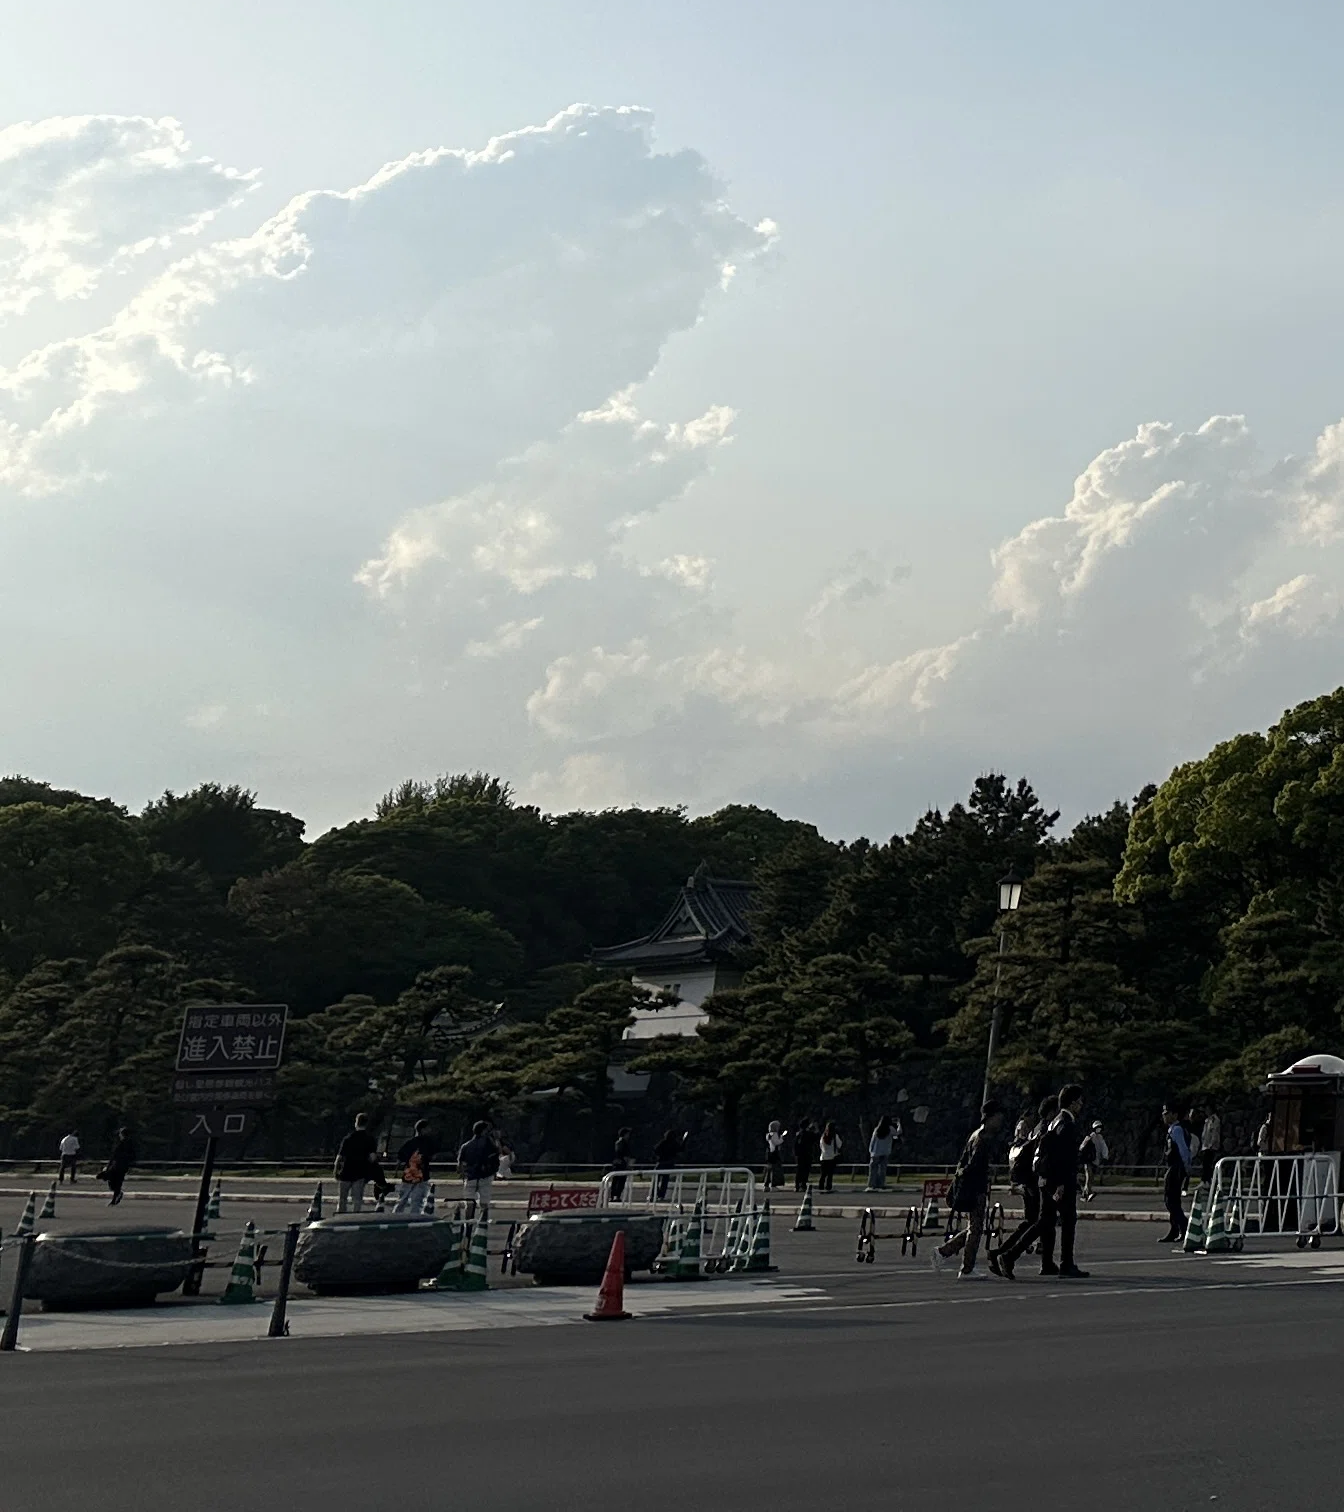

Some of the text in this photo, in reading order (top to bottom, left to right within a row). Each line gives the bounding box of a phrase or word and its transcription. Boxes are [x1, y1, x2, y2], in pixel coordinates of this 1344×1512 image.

[187, 1013, 282, 1028] 指定車両以外
[181, 1034, 278, 1062] 進入禁止
[188, 1114, 245, 1134] 入口
[531, 1193, 600, 1208] 止まってくださ
